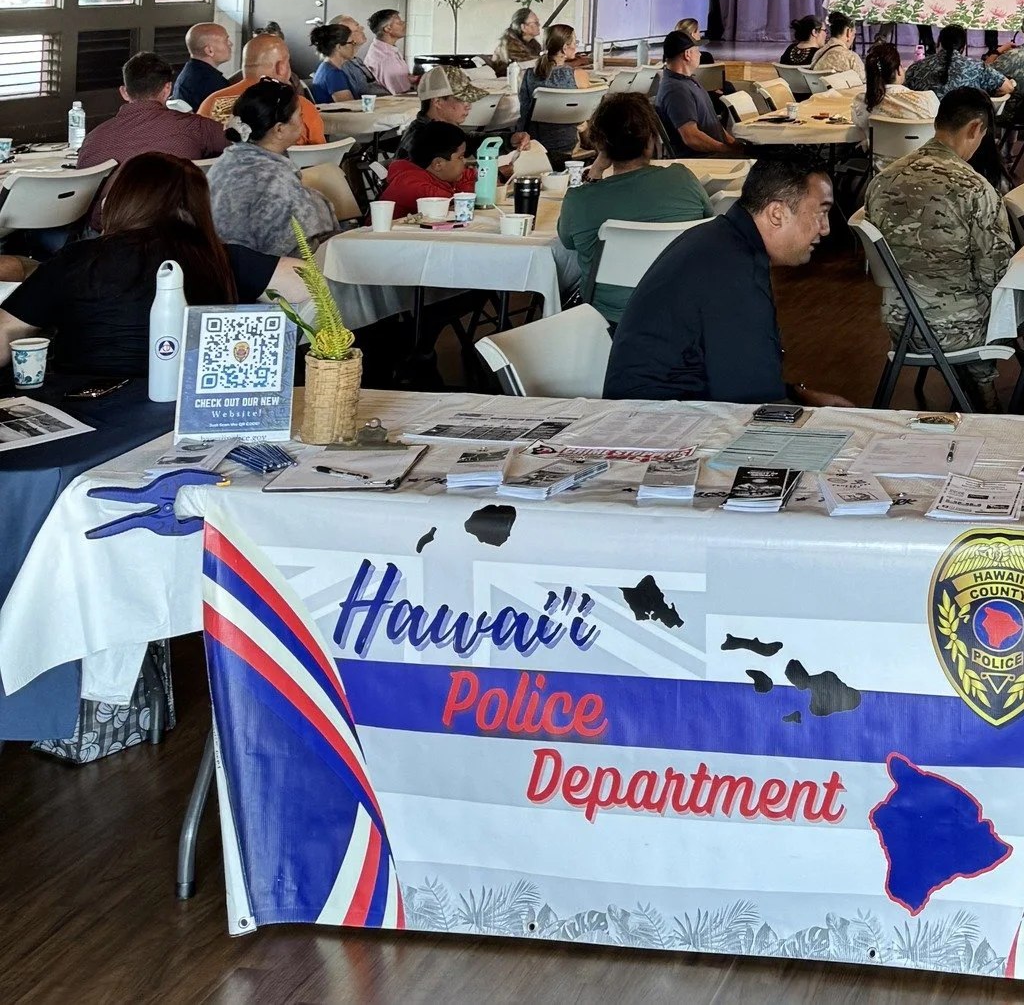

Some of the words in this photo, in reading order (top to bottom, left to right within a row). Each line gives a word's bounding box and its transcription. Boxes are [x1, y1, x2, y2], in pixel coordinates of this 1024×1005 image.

[195, 398, 222, 408] CHECK
[224, 397, 240, 407] OUT
[242, 397, 258, 407] OUR
[260, 396, 280, 406] NEW
[212, 409, 262, 418] Website!
[973, 571, 1024, 585] HAWAII
[973, 651, 1023, 669] POLICE
[442, 670, 609, 737] Police
[526, 747, 848, 824] Department
